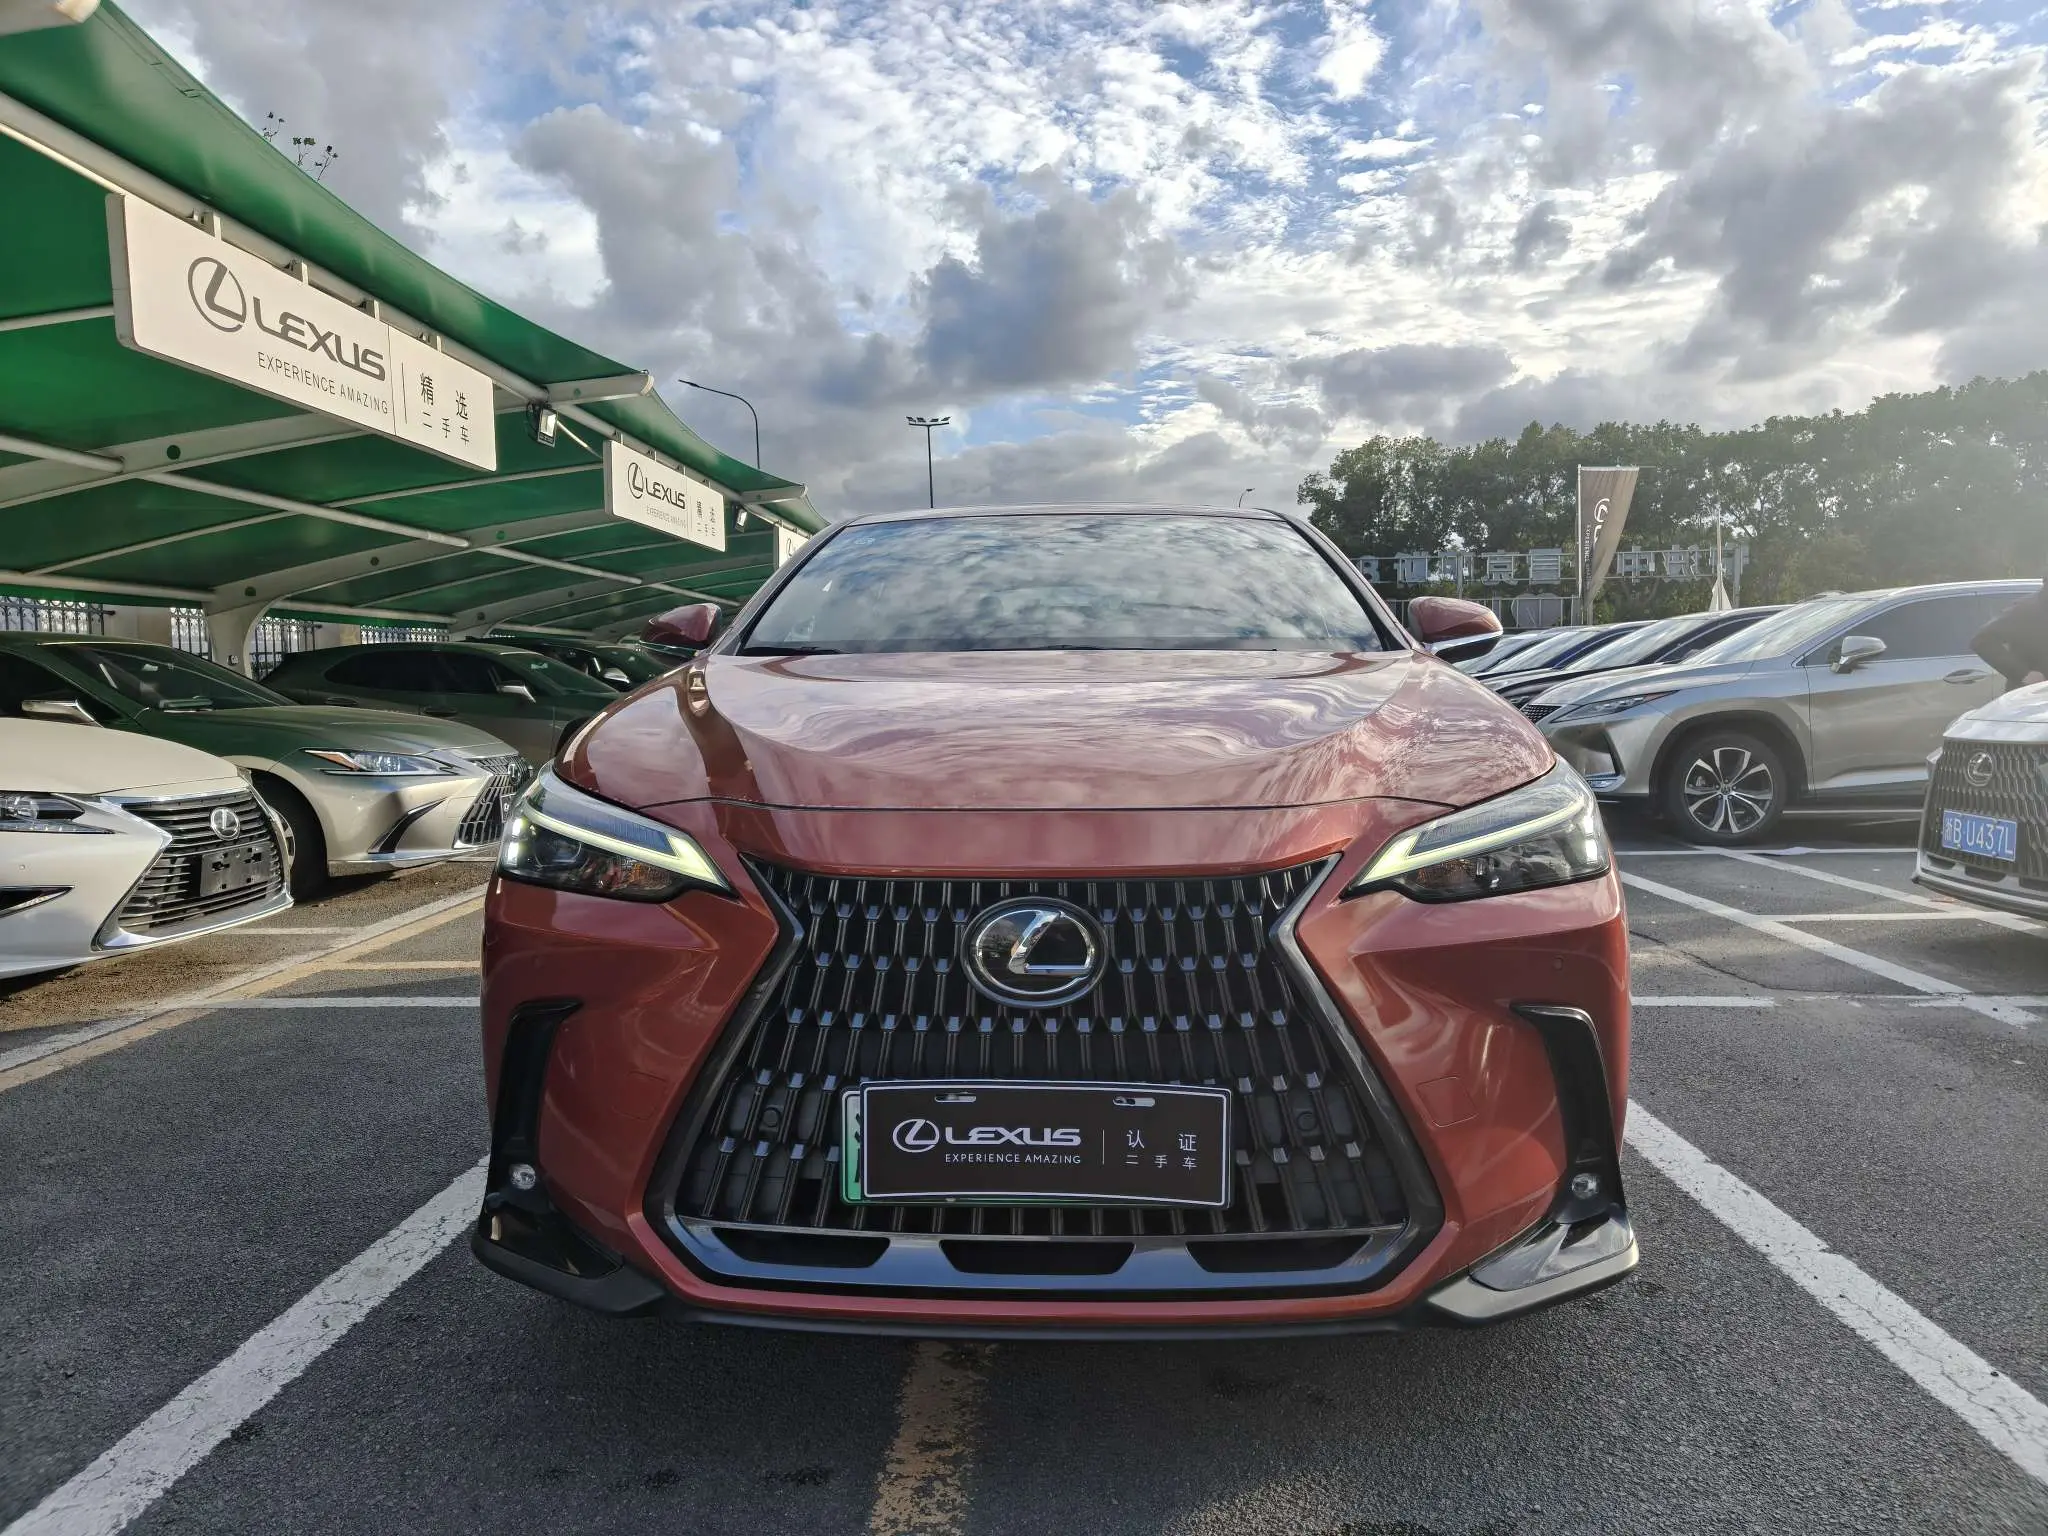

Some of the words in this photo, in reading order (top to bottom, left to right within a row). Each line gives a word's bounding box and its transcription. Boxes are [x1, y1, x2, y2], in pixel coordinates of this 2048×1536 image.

[253, 296, 385, 381] LEXUS
[258, 352, 335, 395] EXPERIENCE
[340, 383, 389, 415] AMAZING
[421, 374, 469, 420] 精选
[422, 412, 470, 445] 二手车
[645, 477, 685, 509] LEXUS
[945, 1127, 1081, 1146] LEXUS
[1126, 1129, 1197, 1152] 认证
[945, 1153, 1021, 1164] EXPERIENCE
[1025, 1154, 1081, 1165] AMAZING
[1126, 1154, 1198, 1170] 二手车
